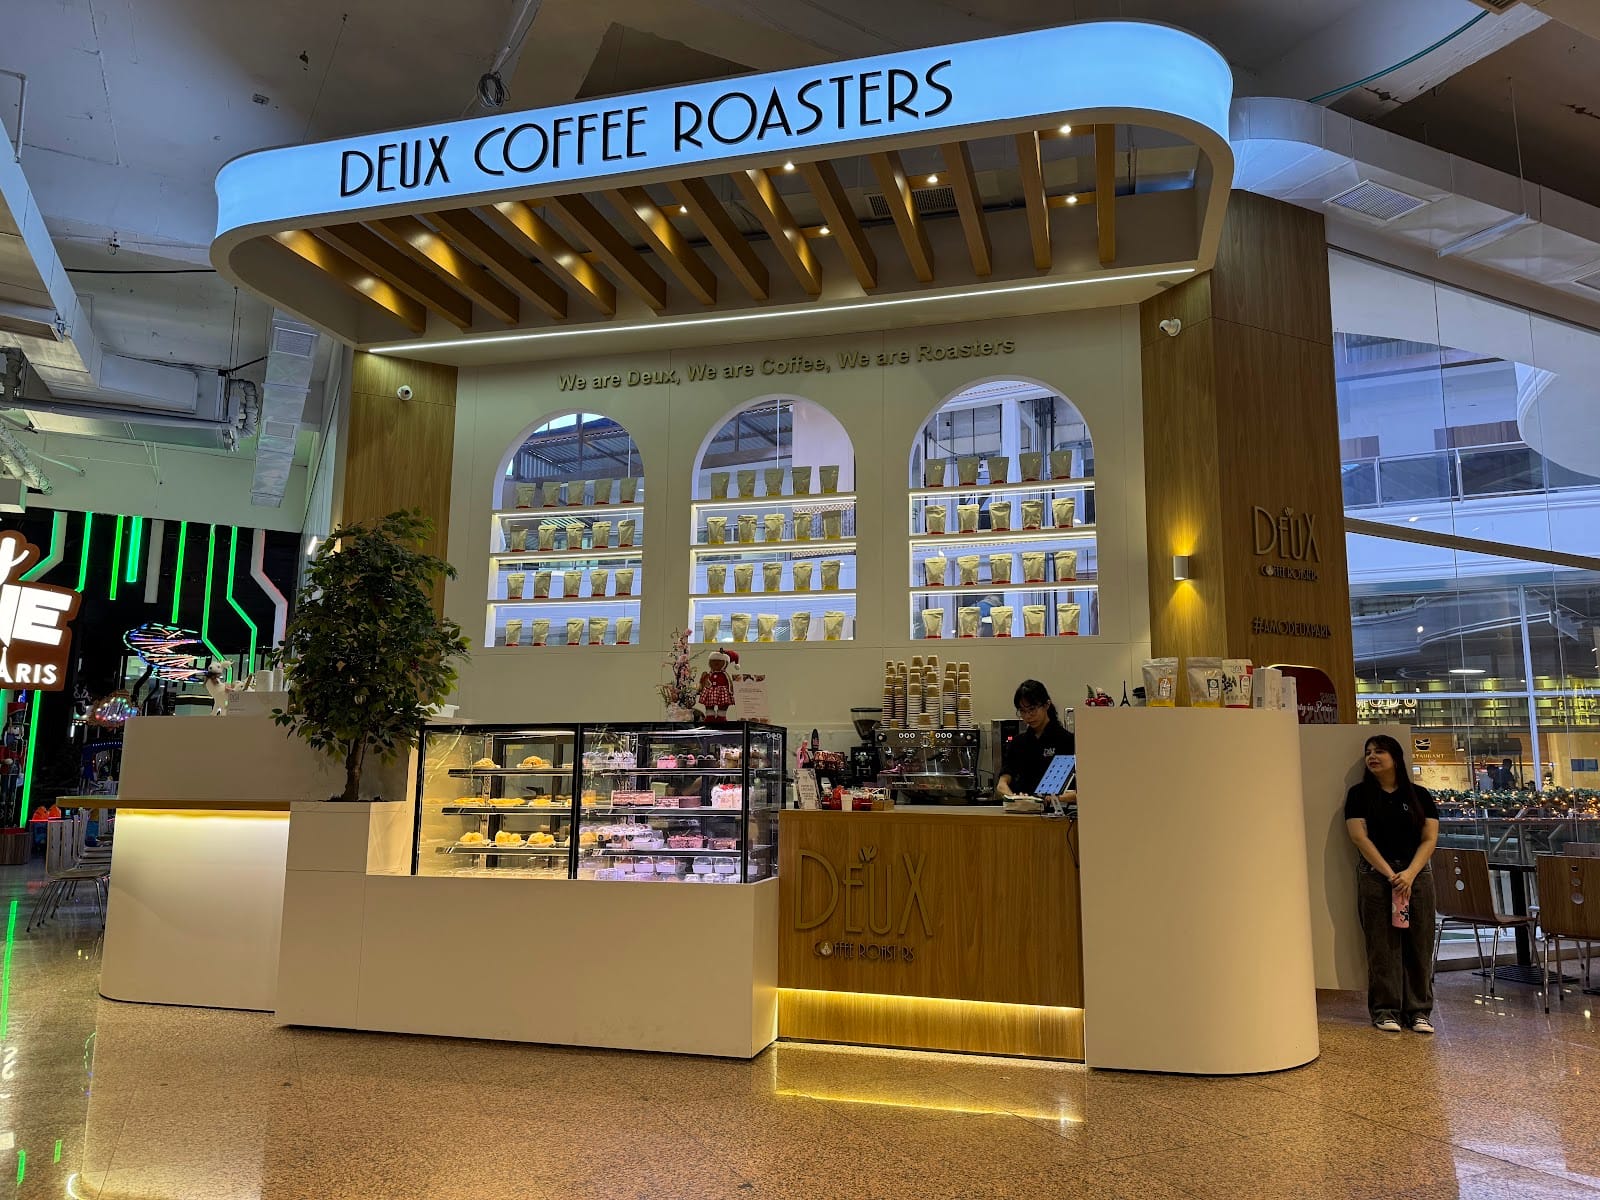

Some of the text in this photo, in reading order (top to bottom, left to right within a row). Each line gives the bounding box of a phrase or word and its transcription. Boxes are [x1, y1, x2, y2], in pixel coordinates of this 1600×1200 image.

[339, 58, 953, 199] DEUX COFFEE ROASTERS
[558, 336, 1016, 391] We are Deux, We are Coffee, We are Roasters
[1252, 504, 1321, 563] DEUX
[794, 848, 935, 938] DEUX
[813, 940, 854, 959] COFFEE
